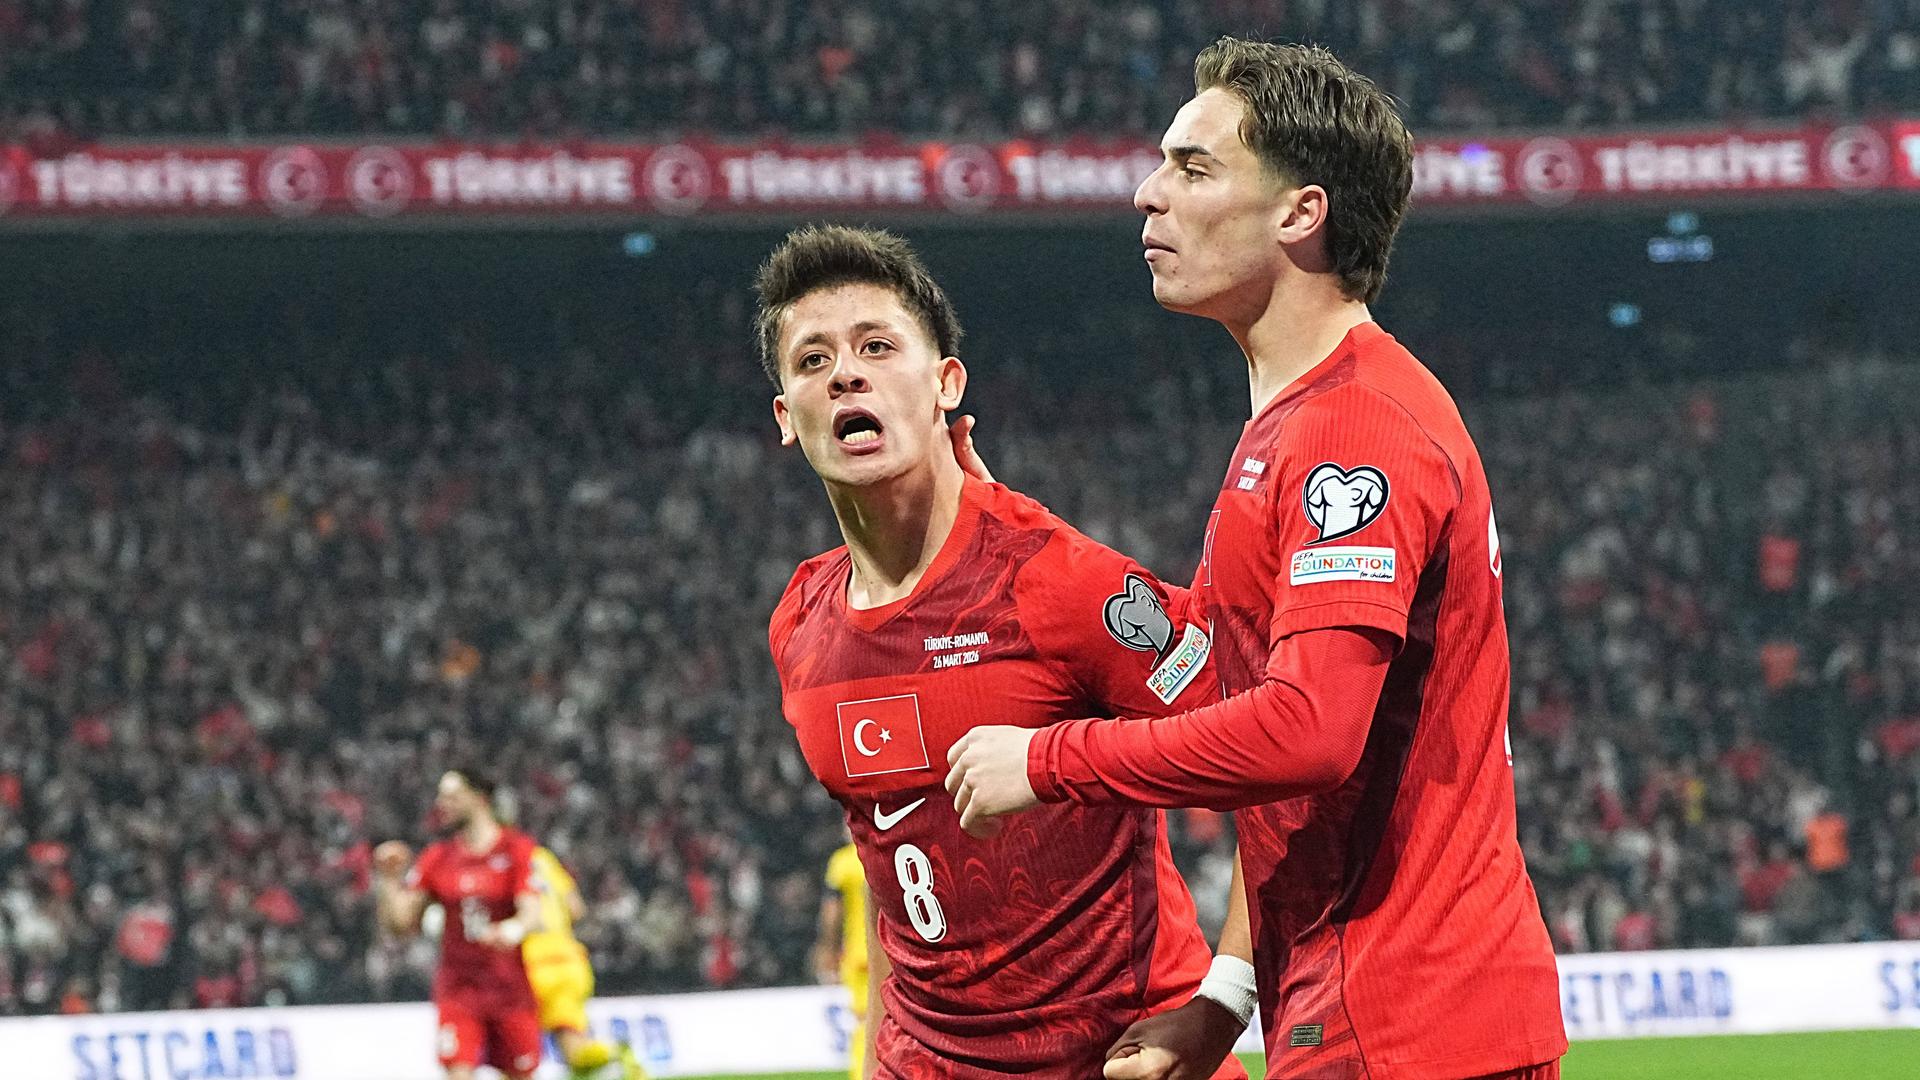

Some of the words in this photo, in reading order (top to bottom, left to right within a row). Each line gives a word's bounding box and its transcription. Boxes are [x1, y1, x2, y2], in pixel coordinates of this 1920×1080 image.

[33, 152, 248, 204] TÜRKİYE
[426, 151, 634, 203] TÜRKİYE
[721, 151, 924, 202] TÜRKİYE
[1599, 137, 1807, 190] TÜRKİYE
[924, 631, 989, 651] TÜRKİYE-ROMANYA
[933, 655, 943, 669] 26
[943, 653, 963, 667] MART
[963, 650, 979, 664] 2026
[894, 843, 947, 943] 8
[1564, 967, 1732, 1025] ETCARD
[71, 1026, 297, 1080] SETCARD
